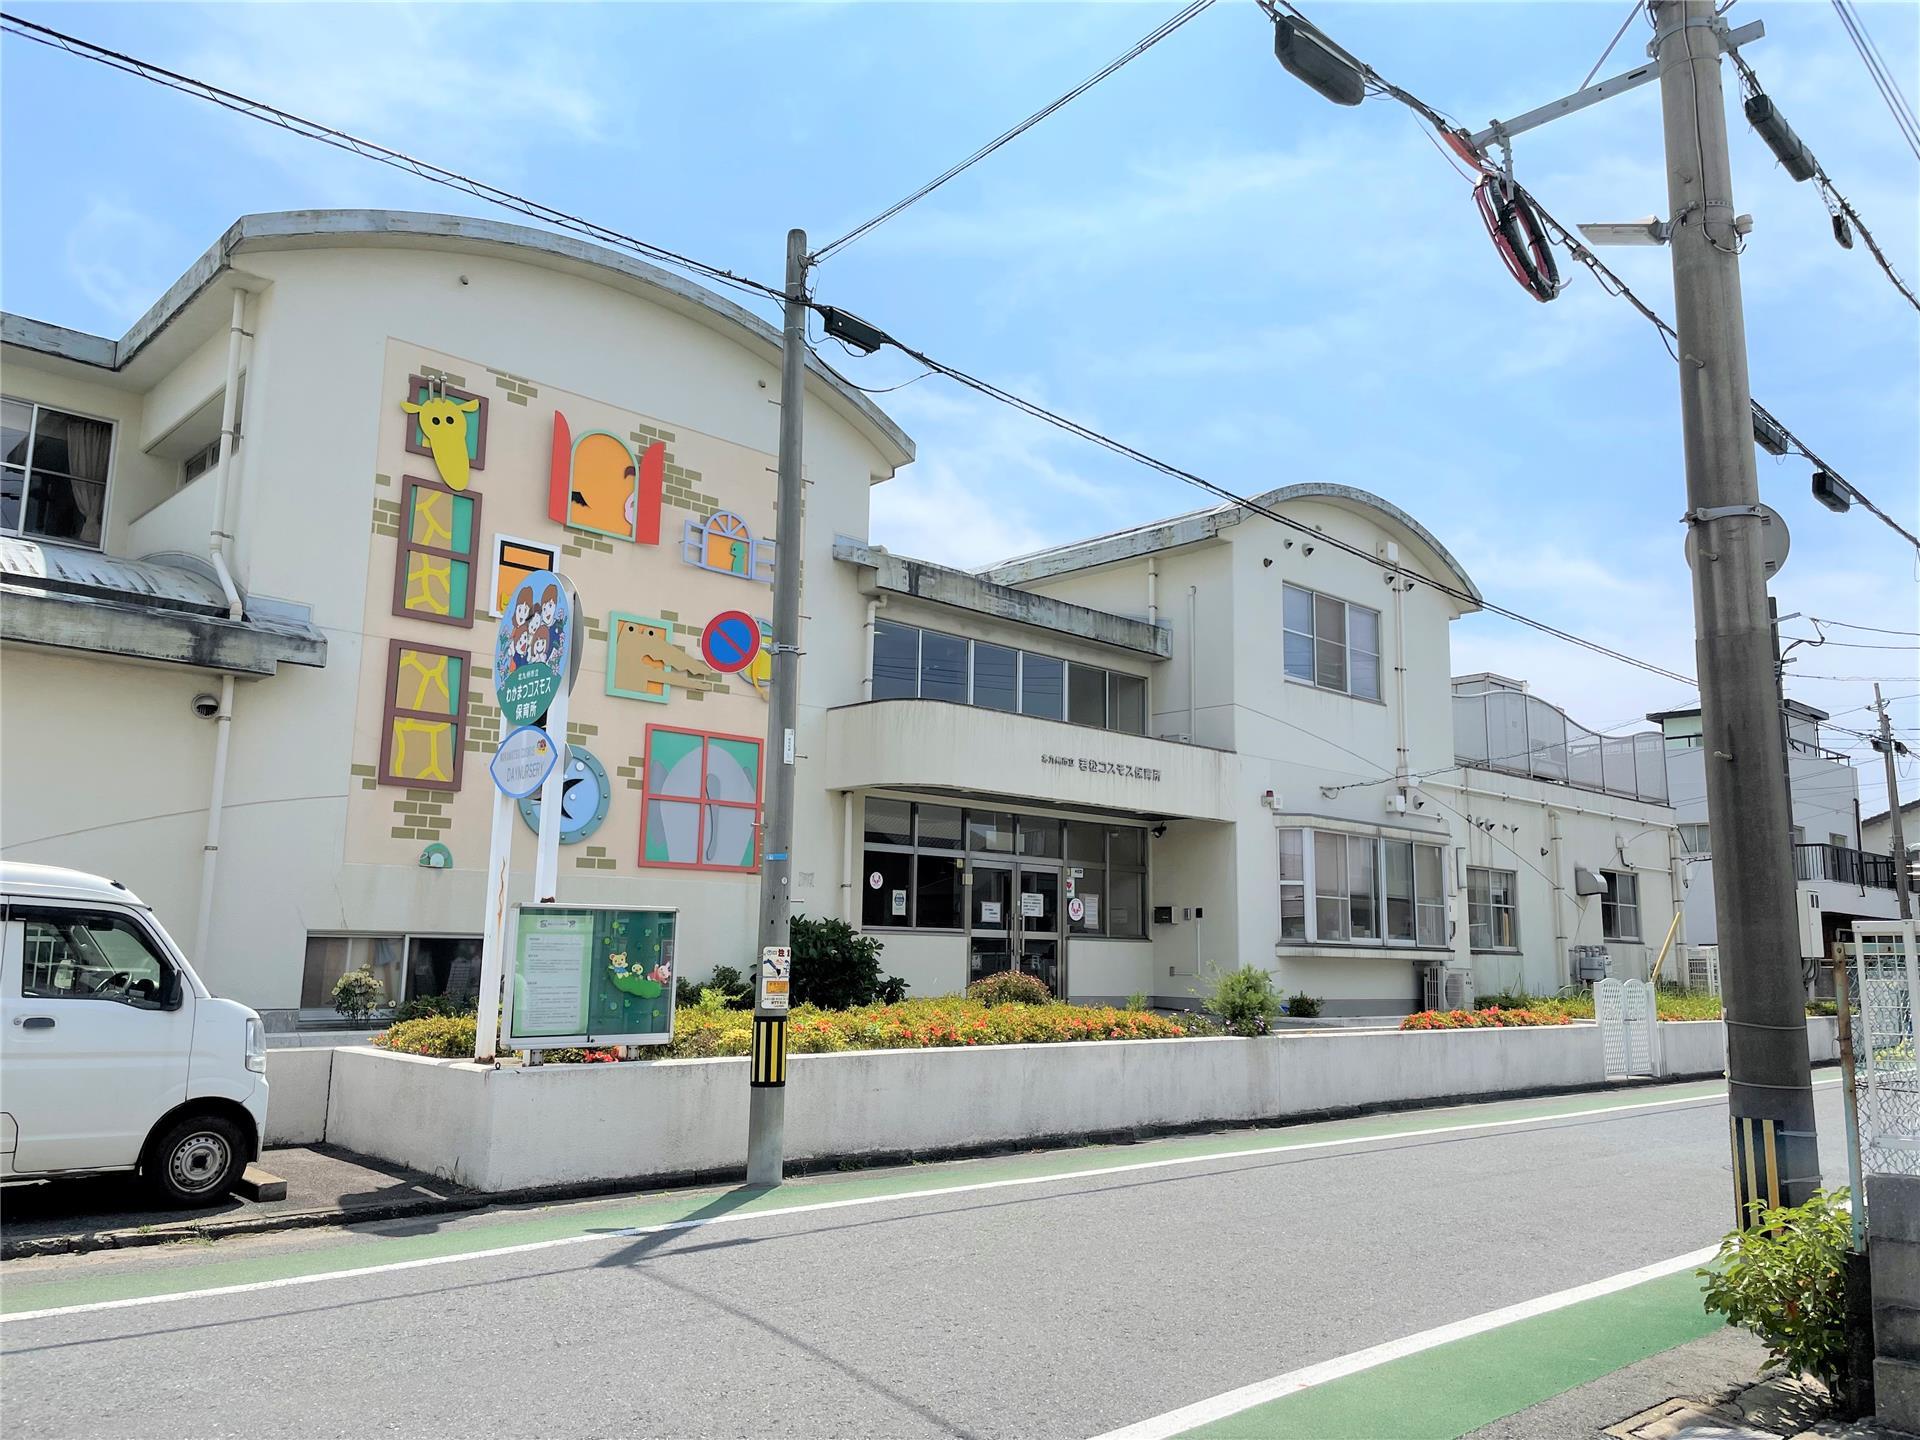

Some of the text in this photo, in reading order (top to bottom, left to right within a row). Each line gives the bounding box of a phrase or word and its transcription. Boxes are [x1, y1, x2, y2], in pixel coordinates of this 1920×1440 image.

[506, 677, 551, 702] わかまつコスモス
[515, 702, 537, 720] 保育所
[1078, 758, 1161, 781] 若松コスモス保育所
